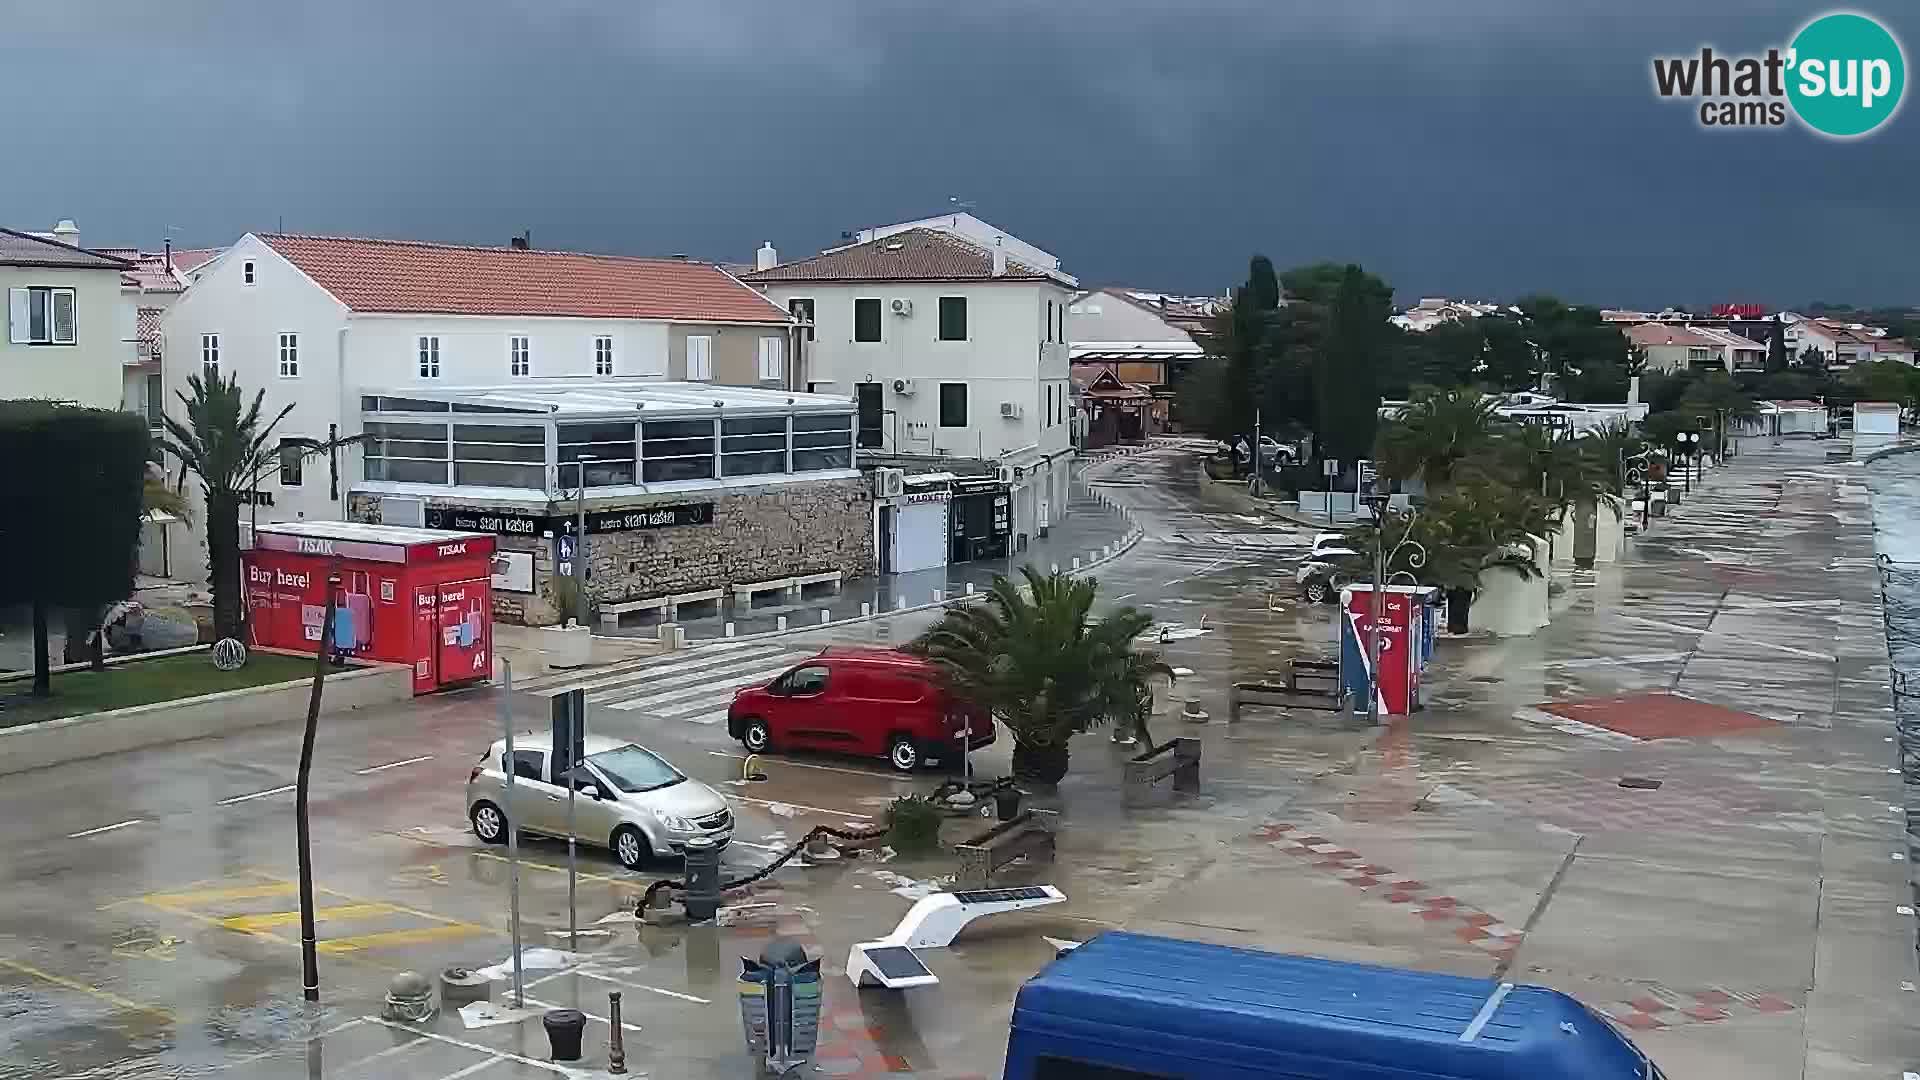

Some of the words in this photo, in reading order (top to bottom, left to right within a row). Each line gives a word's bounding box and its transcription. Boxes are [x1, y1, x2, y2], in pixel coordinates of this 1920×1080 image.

[296, 537, 334, 554] TISAK
[438, 543, 466, 557] TISAK
[250, 565, 272, 588] Buy
[276, 567, 310, 589] here!
[418, 594, 437, 607] Buy
[441, 588, 465, 603] here!
